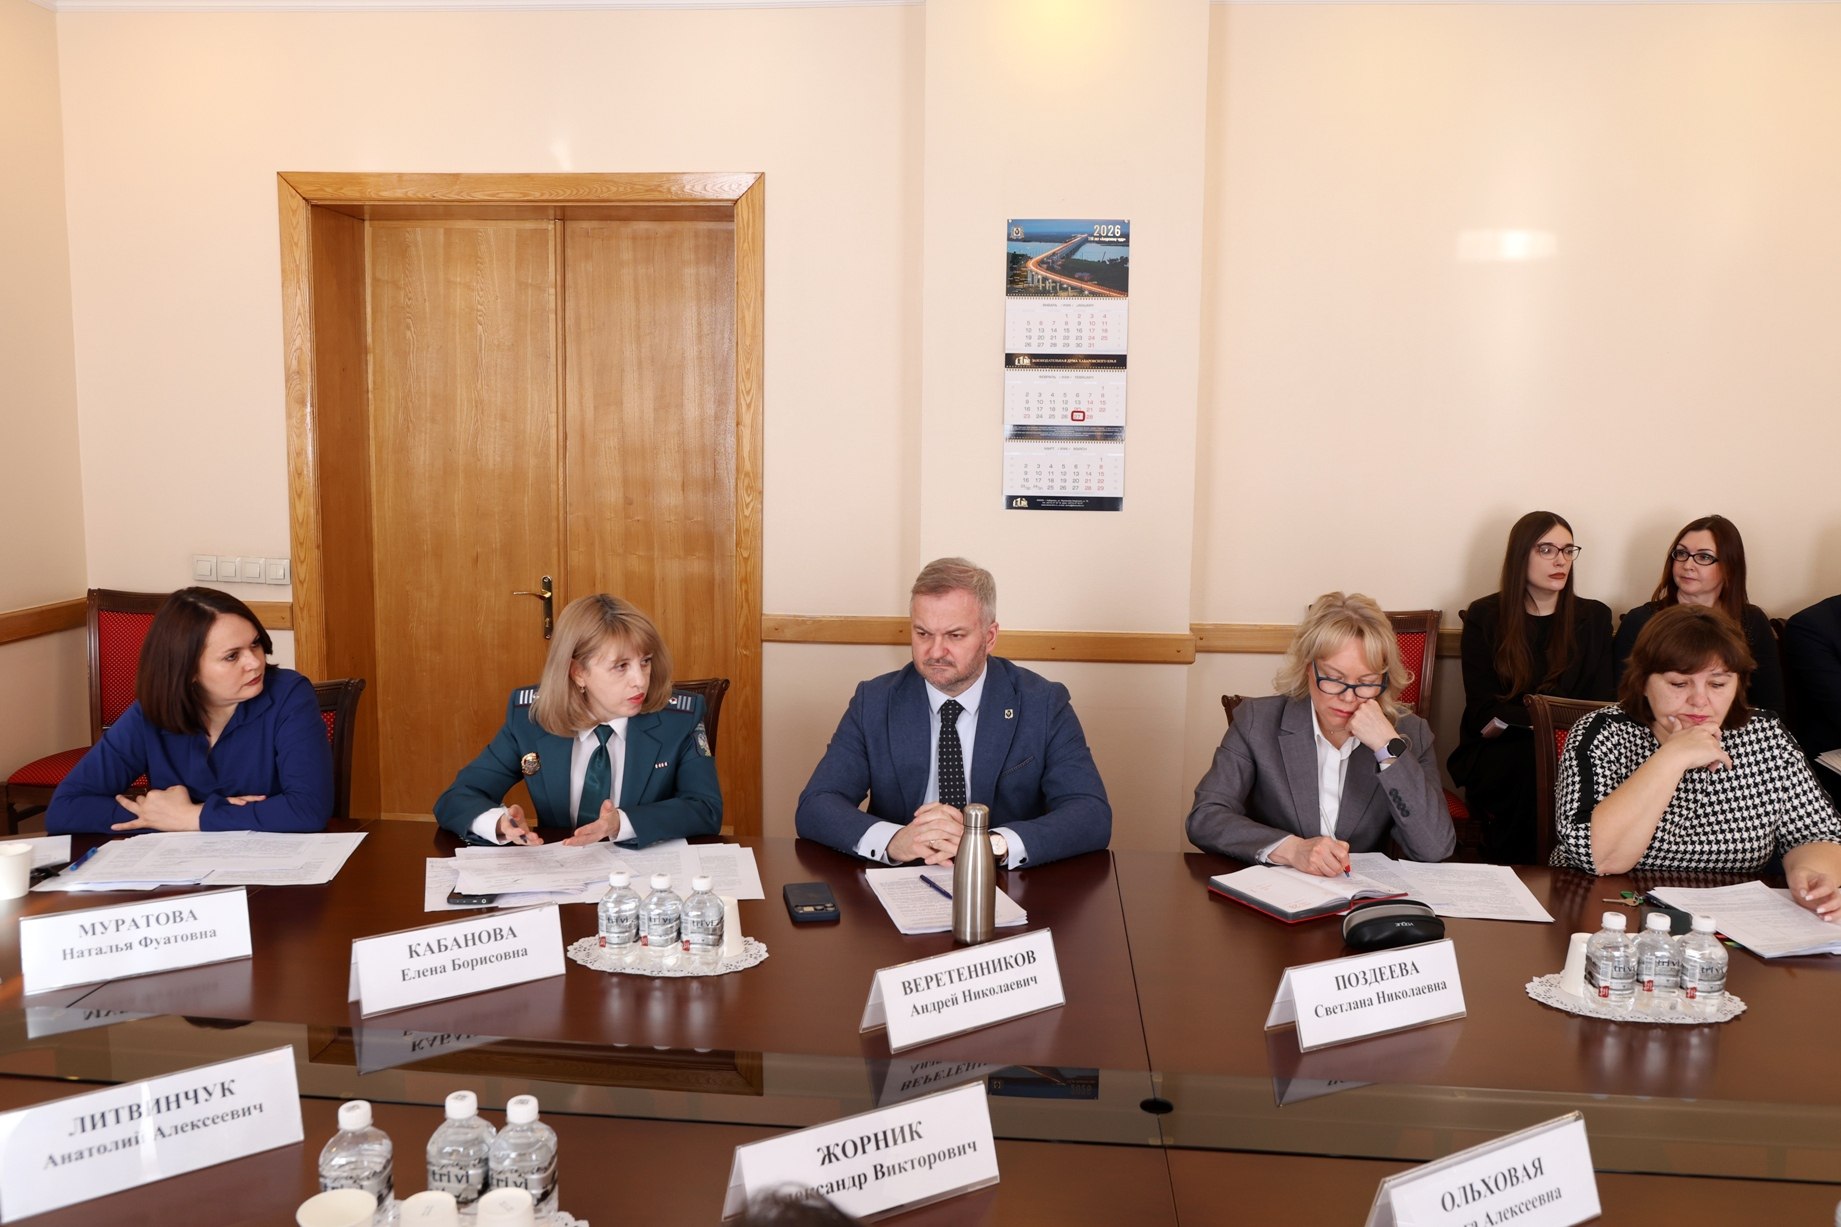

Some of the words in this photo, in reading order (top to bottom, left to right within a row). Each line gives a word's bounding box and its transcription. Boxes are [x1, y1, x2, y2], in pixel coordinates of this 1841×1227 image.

[1094, 225, 1121, 236] 2026
[79, 909, 198, 938] МУРАТОВА
[408, 925, 517, 959] КАБАНОВА
[62, 941, 133, 960] Наталья
[139, 929, 217, 950] Фуатовна
[401, 964, 447, 982] Елена
[452, 947, 528, 972] Борисовна
[901, 949, 1037, 996] ВЕРЕТЕННИКОВ
[1334, 960, 1420, 991] ПОЗДЕЕВА
[910, 993, 959, 1017] Андрей
[962, 975, 1038, 1003] Николаевич
[1314, 998, 1374, 1019] Светлана
[1376, 980, 1447, 1005] Николаевна
[68, 1079, 236, 1137] ЛИТВИНЧУК
[153, 1102, 264, 1141] Алексеевич
[816, 1120, 923, 1167] ЖОРНИК
[784, 1171, 868, 1201] ександр
[872, 1140, 978, 1181] Викторович
[1441, 1157, 1545, 1213] ОЛЬХОВАЯ
[1483, 1187, 1562, 1227] Алексеевна
